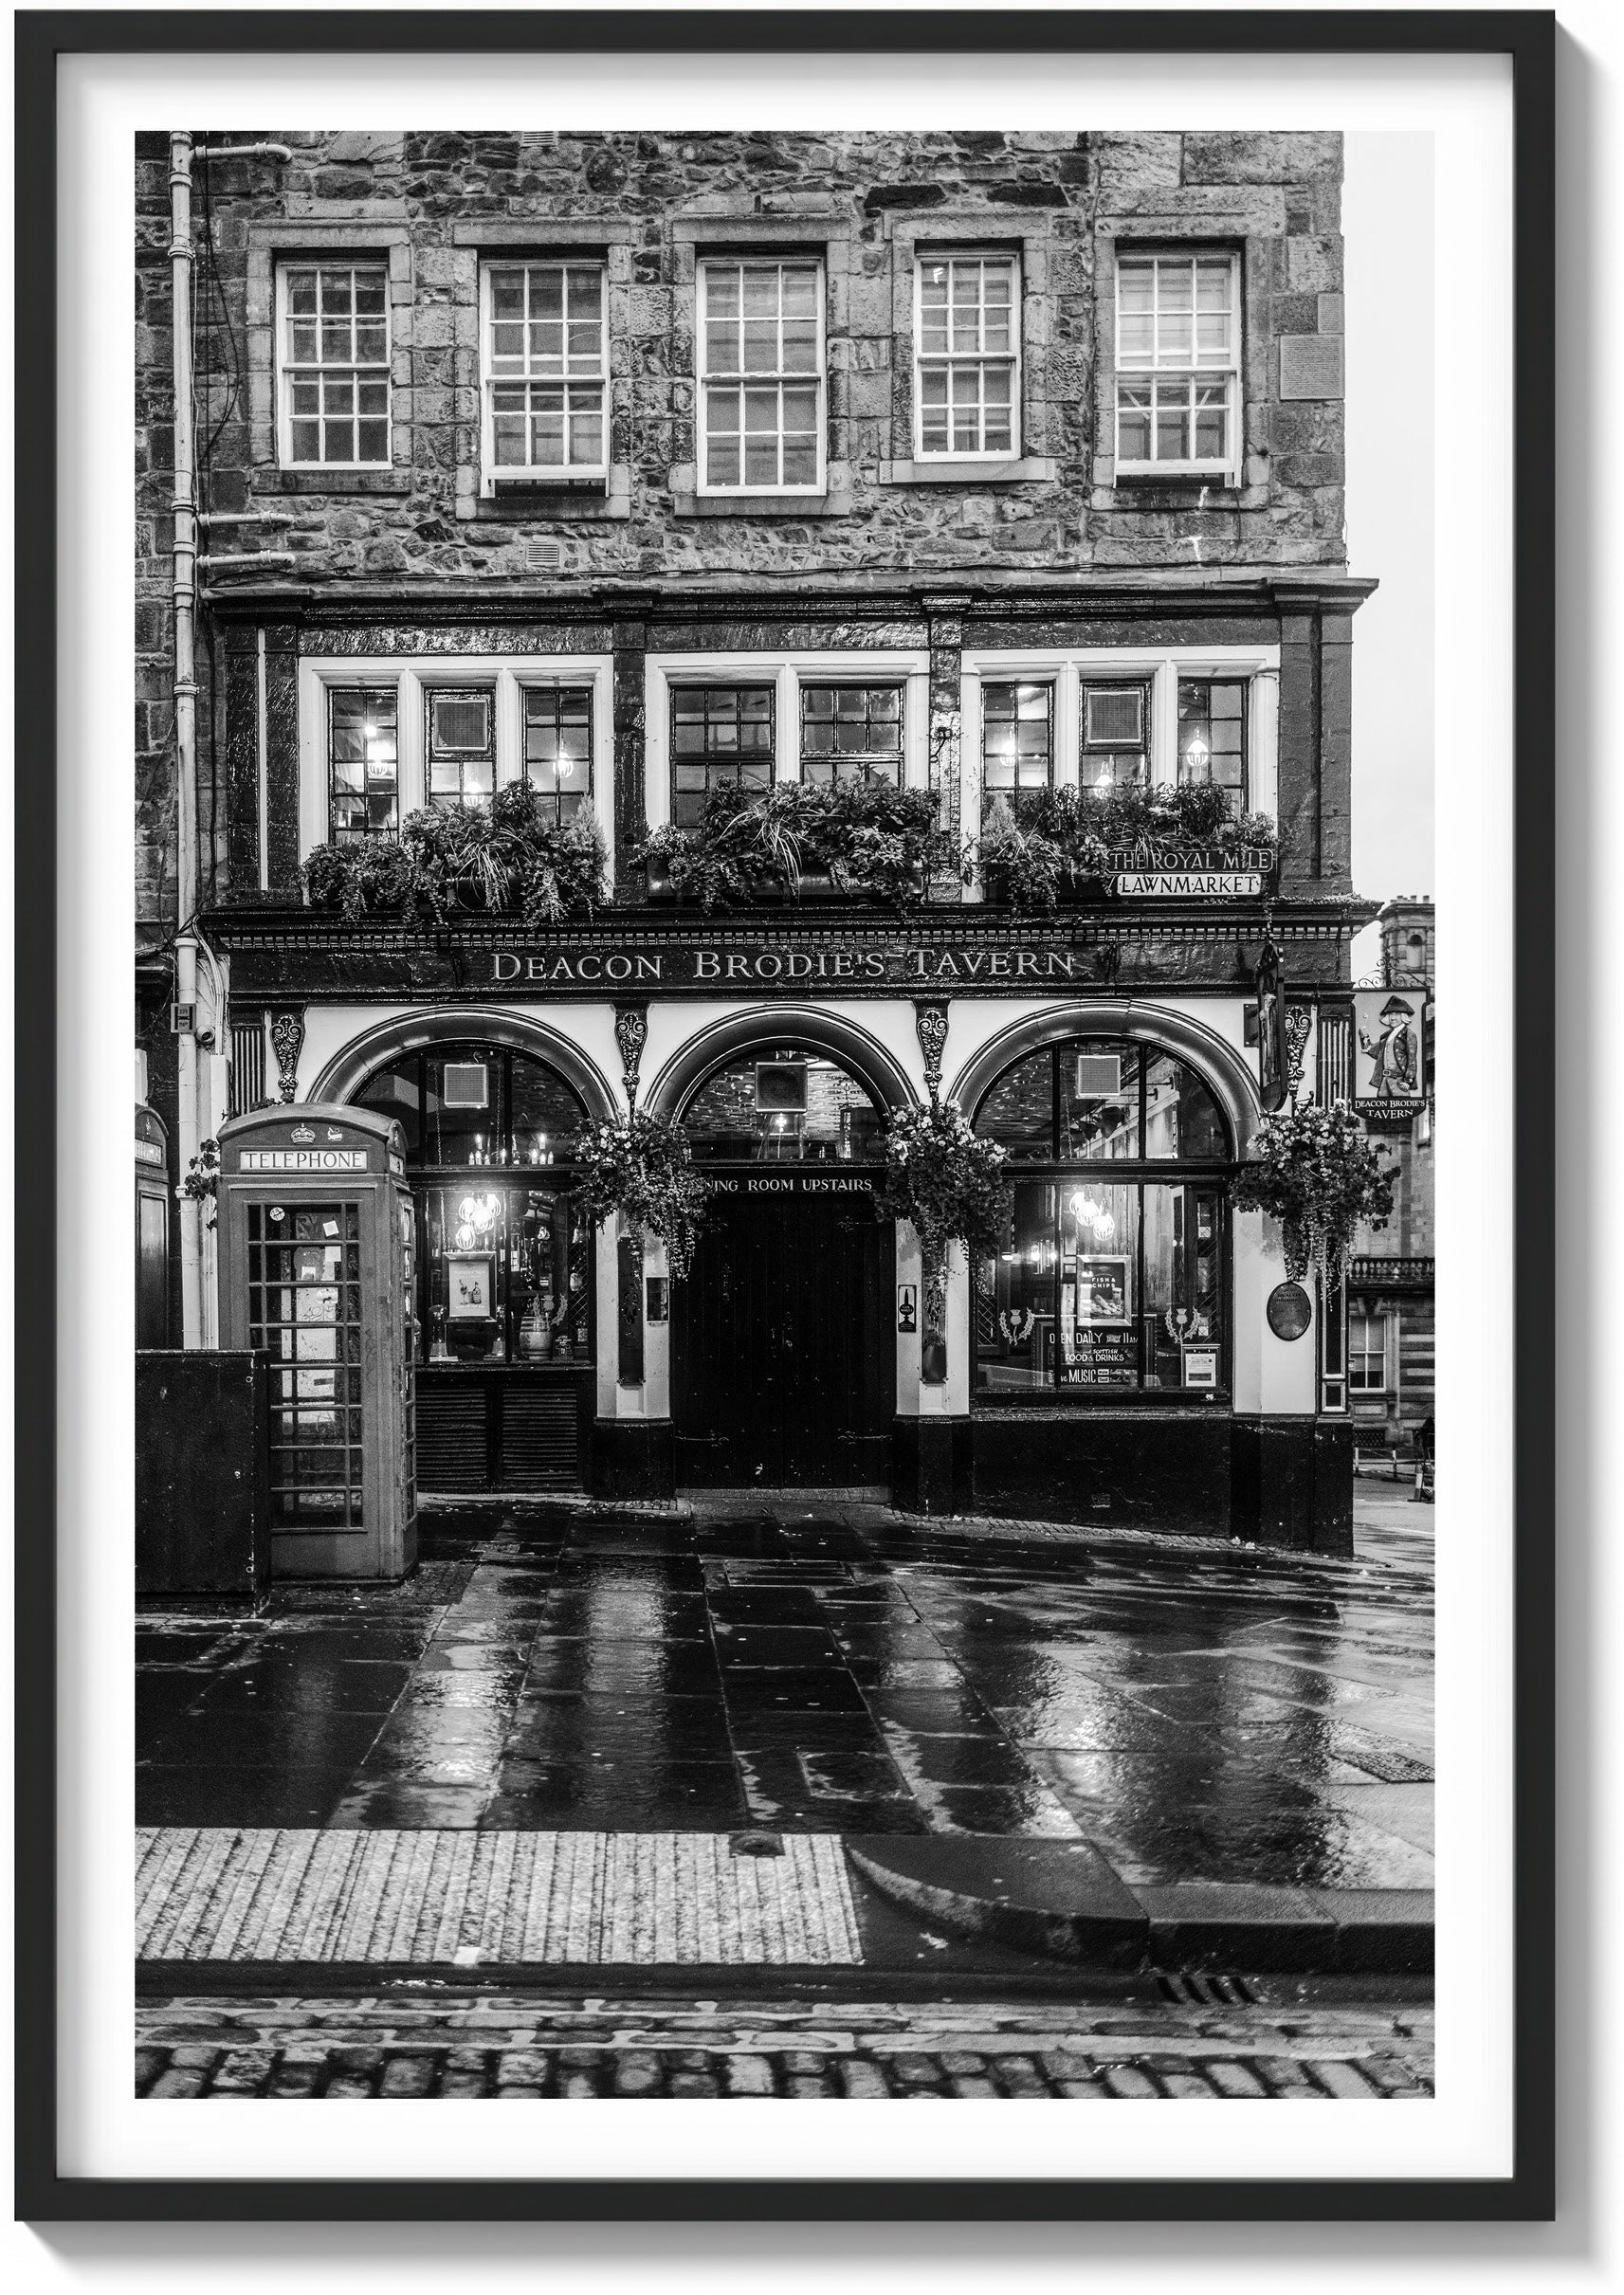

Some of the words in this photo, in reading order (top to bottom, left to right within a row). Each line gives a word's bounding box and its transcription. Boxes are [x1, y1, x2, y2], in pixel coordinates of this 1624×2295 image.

[1110, 852, 1146, 869] THE
[1152, 852, 1215, 869] ROYAL
[1222, 852, 1269, 869] MILE
[1121, 876, 1257, 894] LAWNMARKET
[490, 953, 663, 980] DEACON
[692, 951, 885, 978] BRODIE'S
[906, 949, 1074, 977] TAVERN
[1355, 1100, 1388, 1109] DEACON
[1389, 1100, 1426, 1108] BRODIE'S
[1365, 1109, 1414, 1119] TAVERN
[245, 1152, 362, 1168] TELEPHONE
[747, 1179, 794, 1192] ROOM
[802, 1178, 872, 1192] UPSTAIRS
[1049, 1333, 1072, 1344] OEN
[1076, 1332, 1104, 1344] DAILY
[1065, 1354, 1087, 1362] FOOD
[1095, 1354, 1124, 1362] DRINKS
[1068, 1369, 1096, 1383] MUSIC
